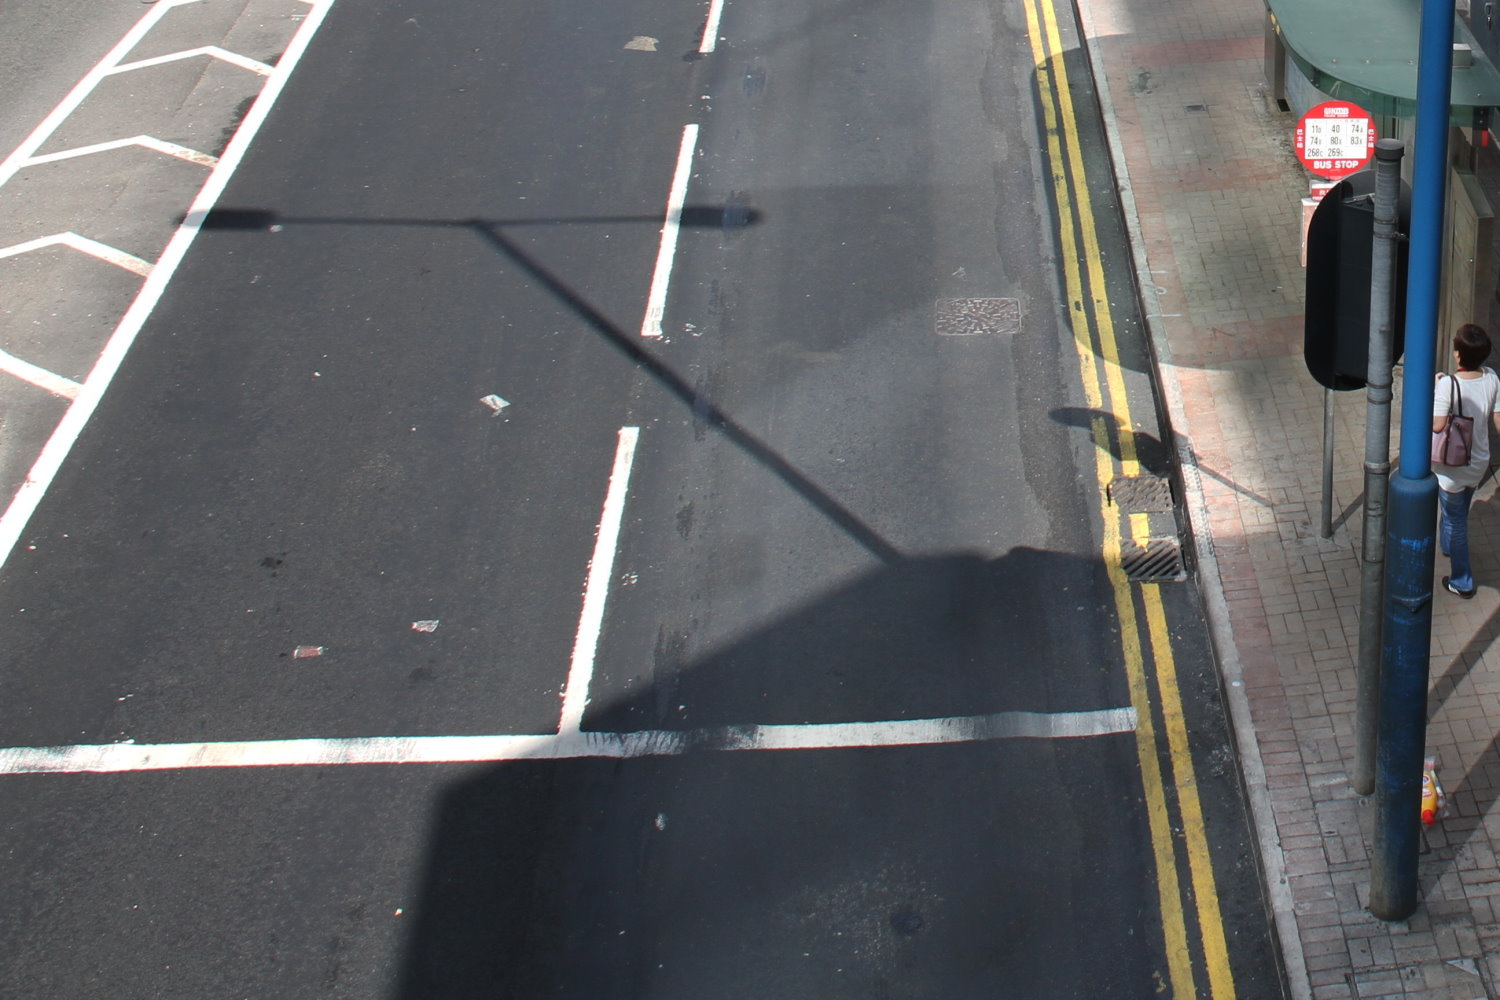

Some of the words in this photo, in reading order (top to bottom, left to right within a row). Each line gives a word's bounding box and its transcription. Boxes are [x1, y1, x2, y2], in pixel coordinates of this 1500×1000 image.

[1331, 124, 1340, 133] 40
[1307, 148, 1323, 157] 268C
[1327, 148, 1343, 157] 269C
[1313, 160, 1332, 169] BUS
[1335, 160, 1359, 169] STOP
